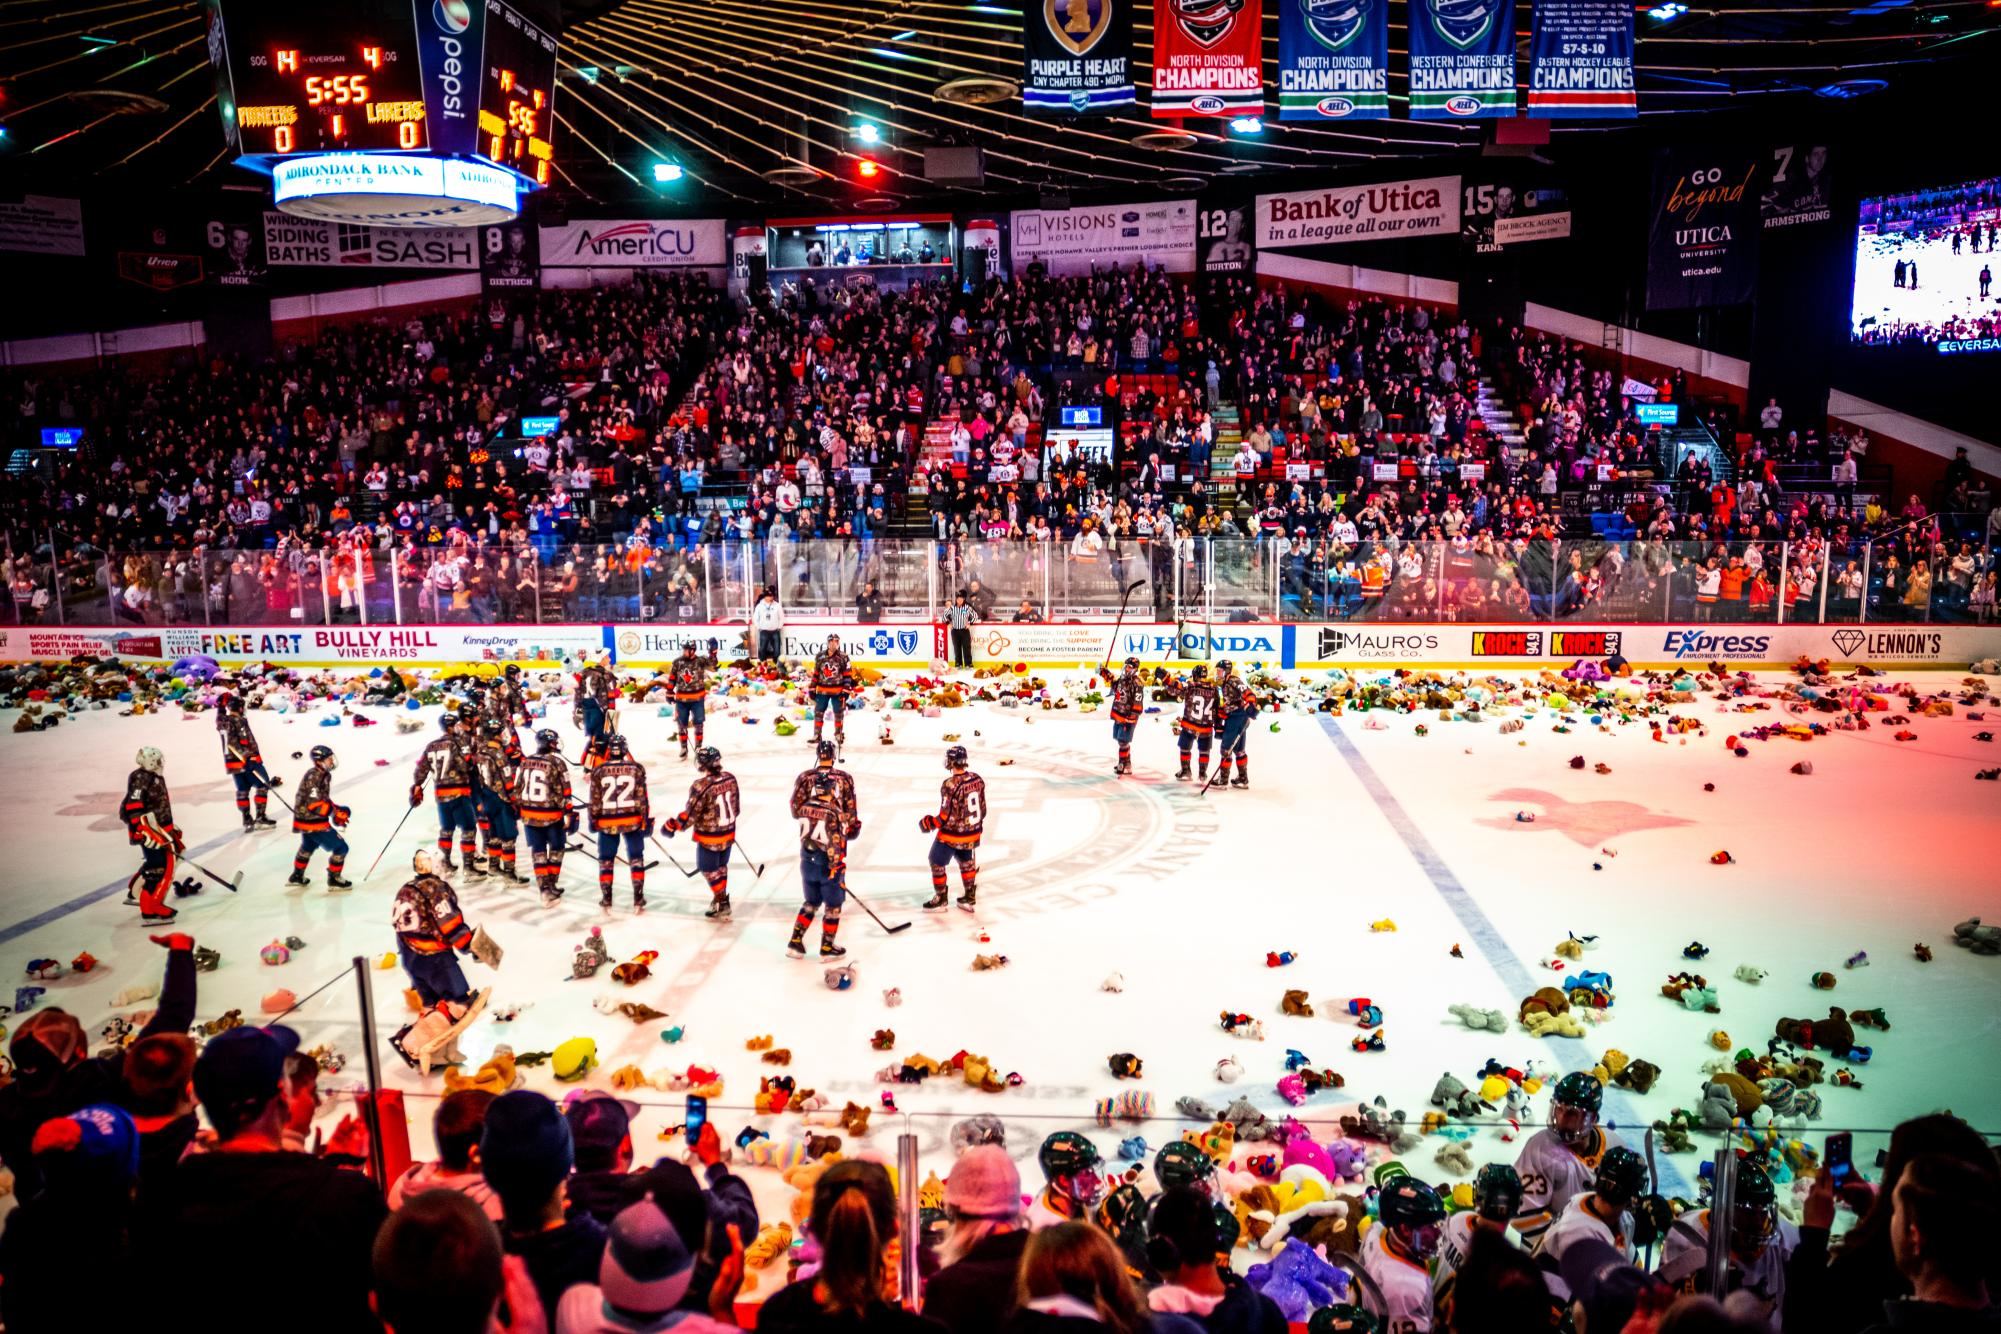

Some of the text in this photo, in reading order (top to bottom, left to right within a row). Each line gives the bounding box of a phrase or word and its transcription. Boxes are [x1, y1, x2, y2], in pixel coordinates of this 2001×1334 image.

[250, 55, 267, 66] SOG
[364, 47, 380, 70] 4
[1563, 44, 1605, 54] 57-5-10
[1031, 57, 1126, 76] PURPLE HEART
[1170, 54, 1244, 67] NORTH DIVISION
[1298, 56, 1372, 68] NORTH DIVISION
[1411, 54, 1513, 68] WESTERN CONFERENCE
[1538, 57, 1631, 67] EASTERN HOCKEY LEAGUE
[439, 36, 464, 119] pepsi
[1033, 76, 1125, 87] CNY CHAPTER 490 MOPH
[1156, 68, 1258, 89] CHAMPIONS
[1281, 69, 1386, 90] CHAMPIONS
[1411, 68, 1514, 89] CHAMPIONS
[1534, 68, 1634, 89] CHAMPIONS
[306, 75, 369, 105] 5:55
[366, 101, 425, 124] LAKERS
[1199, 99, 1221, 109] AHL
[1325, 101, 1347, 111] AHL
[1453, 101, 1475, 110] AHL
[275, 125, 293, 152] 0
[400, 121, 418, 149] 0
[285, 164, 423, 180] ADIRONDACK BANK
[1772, 146, 1794, 183] 7
[1692, 167, 1722, 185] GO
[1465, 185, 1494, 216] 15
[1667, 163, 1755, 222] beyond
[1270, 185, 1441, 222] Bank of Utica
[265, 214, 328, 227] WINDOWS
[1044, 214, 1116, 230] VISIONS
[1200, 211, 1228, 237] 12
[1510, 221, 1535, 231] BROCK
[1537, 217, 1568, 227] AGENCY
[1764, 210, 1830, 228] ARMSTRONG
[207, 220, 226, 249] 6
[267, 229, 329, 244] SIDING
[379, 230, 465, 239] NEW YORK
[1269, 216, 1441, 244] in a league all our own
[1675, 225, 1732, 246] UTICA
[486, 227, 503, 253] 8
[575, 227, 695, 255] AmeriCU
[268, 246, 330, 262] BATHS
[376, 239, 471, 264] SASH
[1680, 248, 1727, 258] UNIVERSITY
[1205, 261, 1242, 271] BURTON
[1682, 265, 1722, 276] utica.edu
[221, 276, 249, 285] HOOK
[489, 277, 533, 287] DIETRICH
[201, 634, 302, 654] FREE ART
[315, 631, 437, 648] BULLY HILL
[463, 635, 518, 646] KinneyDrugs
[1154, 633, 1276, 652] HONDA
[1868, 634, 1941, 653] LENNON'S
[168, 646, 200, 655] ARTS
[338, 648, 418, 658] VINEYARDS
[1192, 696, 1214, 720] 34
[521, 771, 547, 801] 16
[601, 776, 636, 808] 22
[966, 791, 981, 825] 9
[1522, 1174, 1548, 1195] 23
